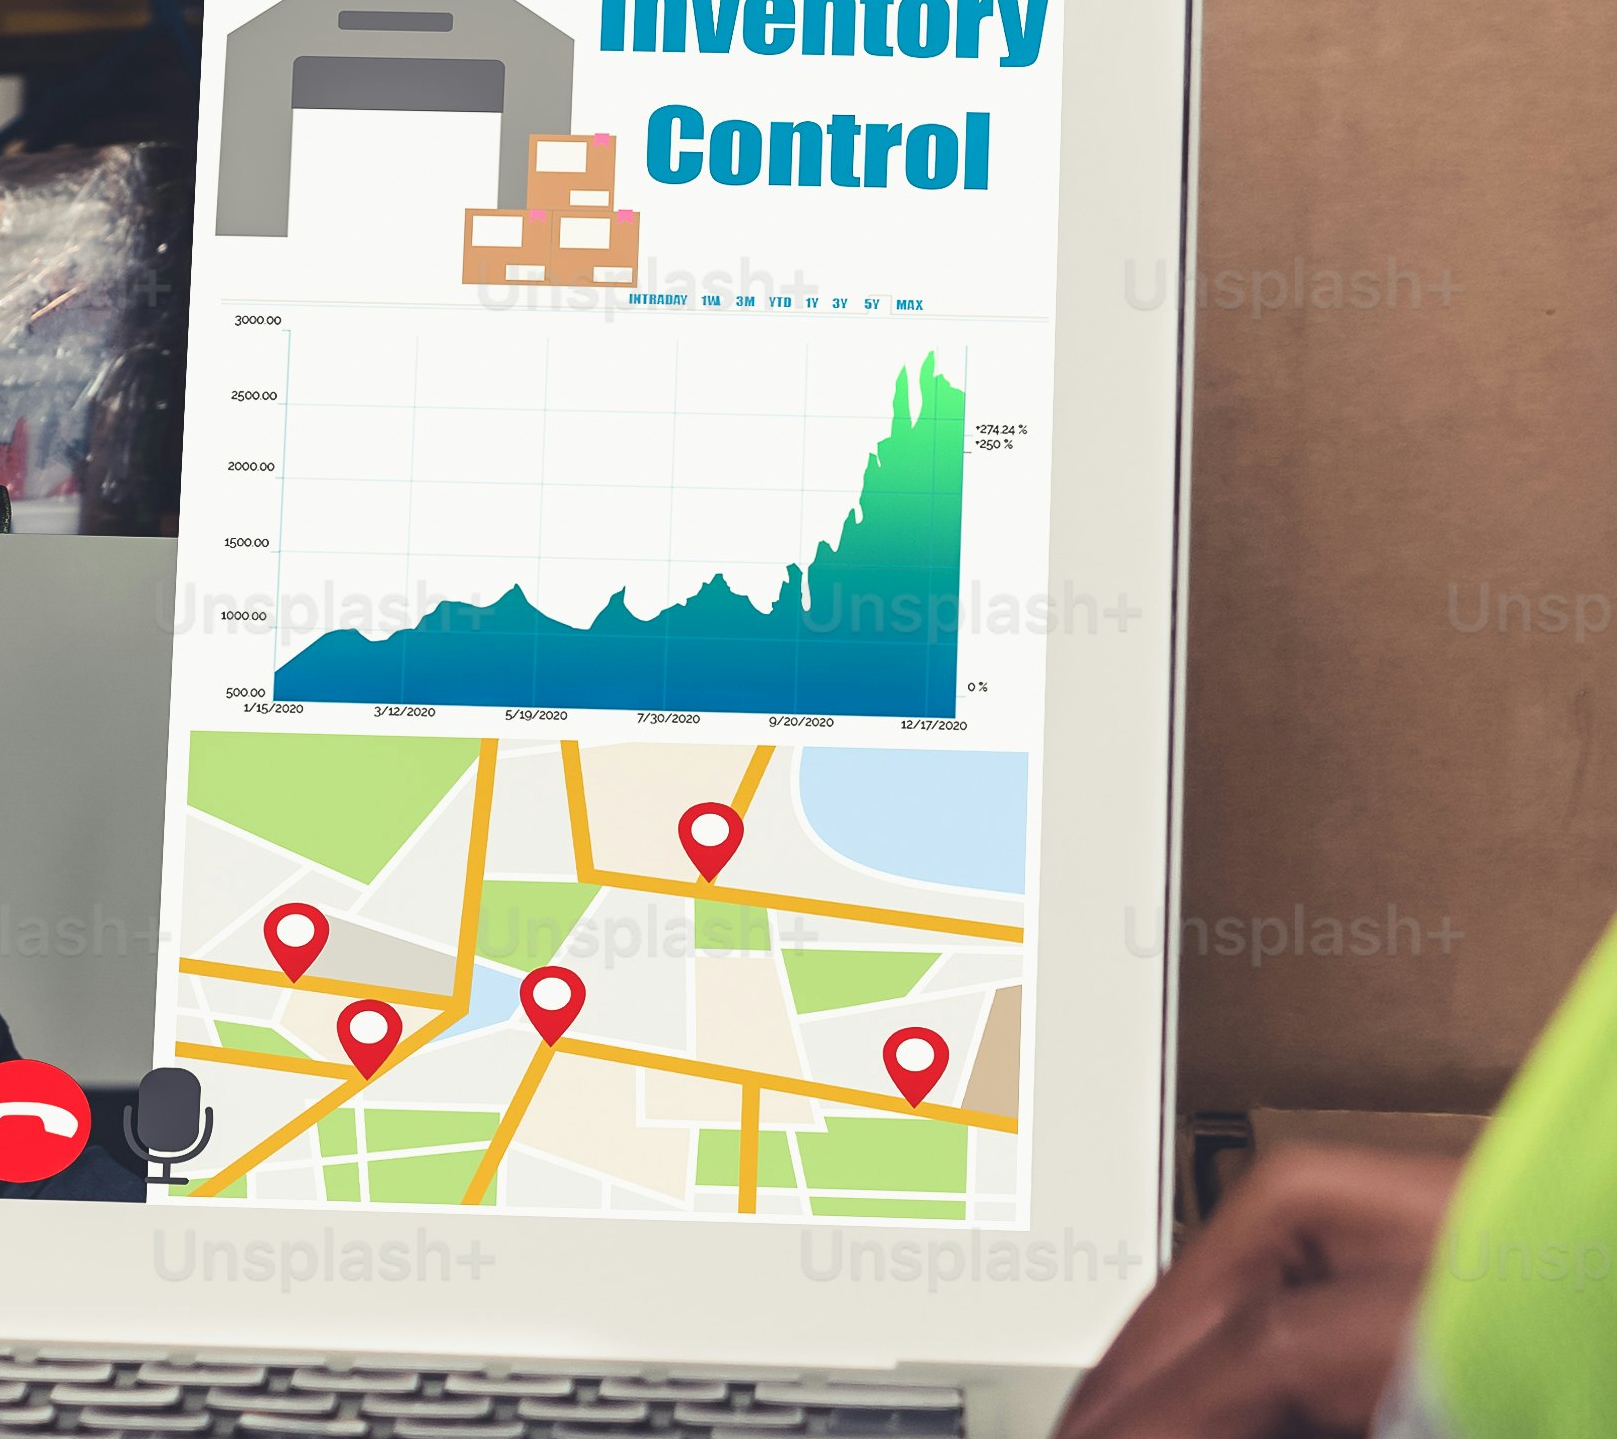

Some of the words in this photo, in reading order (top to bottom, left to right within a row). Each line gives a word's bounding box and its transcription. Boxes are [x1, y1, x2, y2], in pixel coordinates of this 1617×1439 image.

[646, 104, 991, 191] Control
[629, 293, 688, 306] INTRADAY
[735, 295, 755, 307] 3M
[768, 296, 792, 308] YTD
[806, 297, 819, 309] 1Y
[832, 298, 848, 309] 3Y
[864, 298, 880, 310] 5Y
[896, 299, 924, 311] MAX
[234, 314, 282, 327] 3000.00
[230, 390, 278, 402] 2500.00
[1018, 423, 1028, 435] %
[1003, 438, 1014, 450] %
[227, 461, 276, 472] 2000.00
[224, 537, 270, 549] 1500.00
[220, 610, 268, 622] 1000.00
[978, 681, 988, 693] %
[225, 687, 266, 700] 500.00
[243, 703, 304, 715] 1/15/2020
[373, 706, 436, 718] 3/12/2020
[505, 709, 568, 722] 5/19/2020
[637, 711, 701, 725] 7/30/2020
[768, 715, 835, 729] 9/20/2020
[900, 719, 968, 732] 12/17/2020
